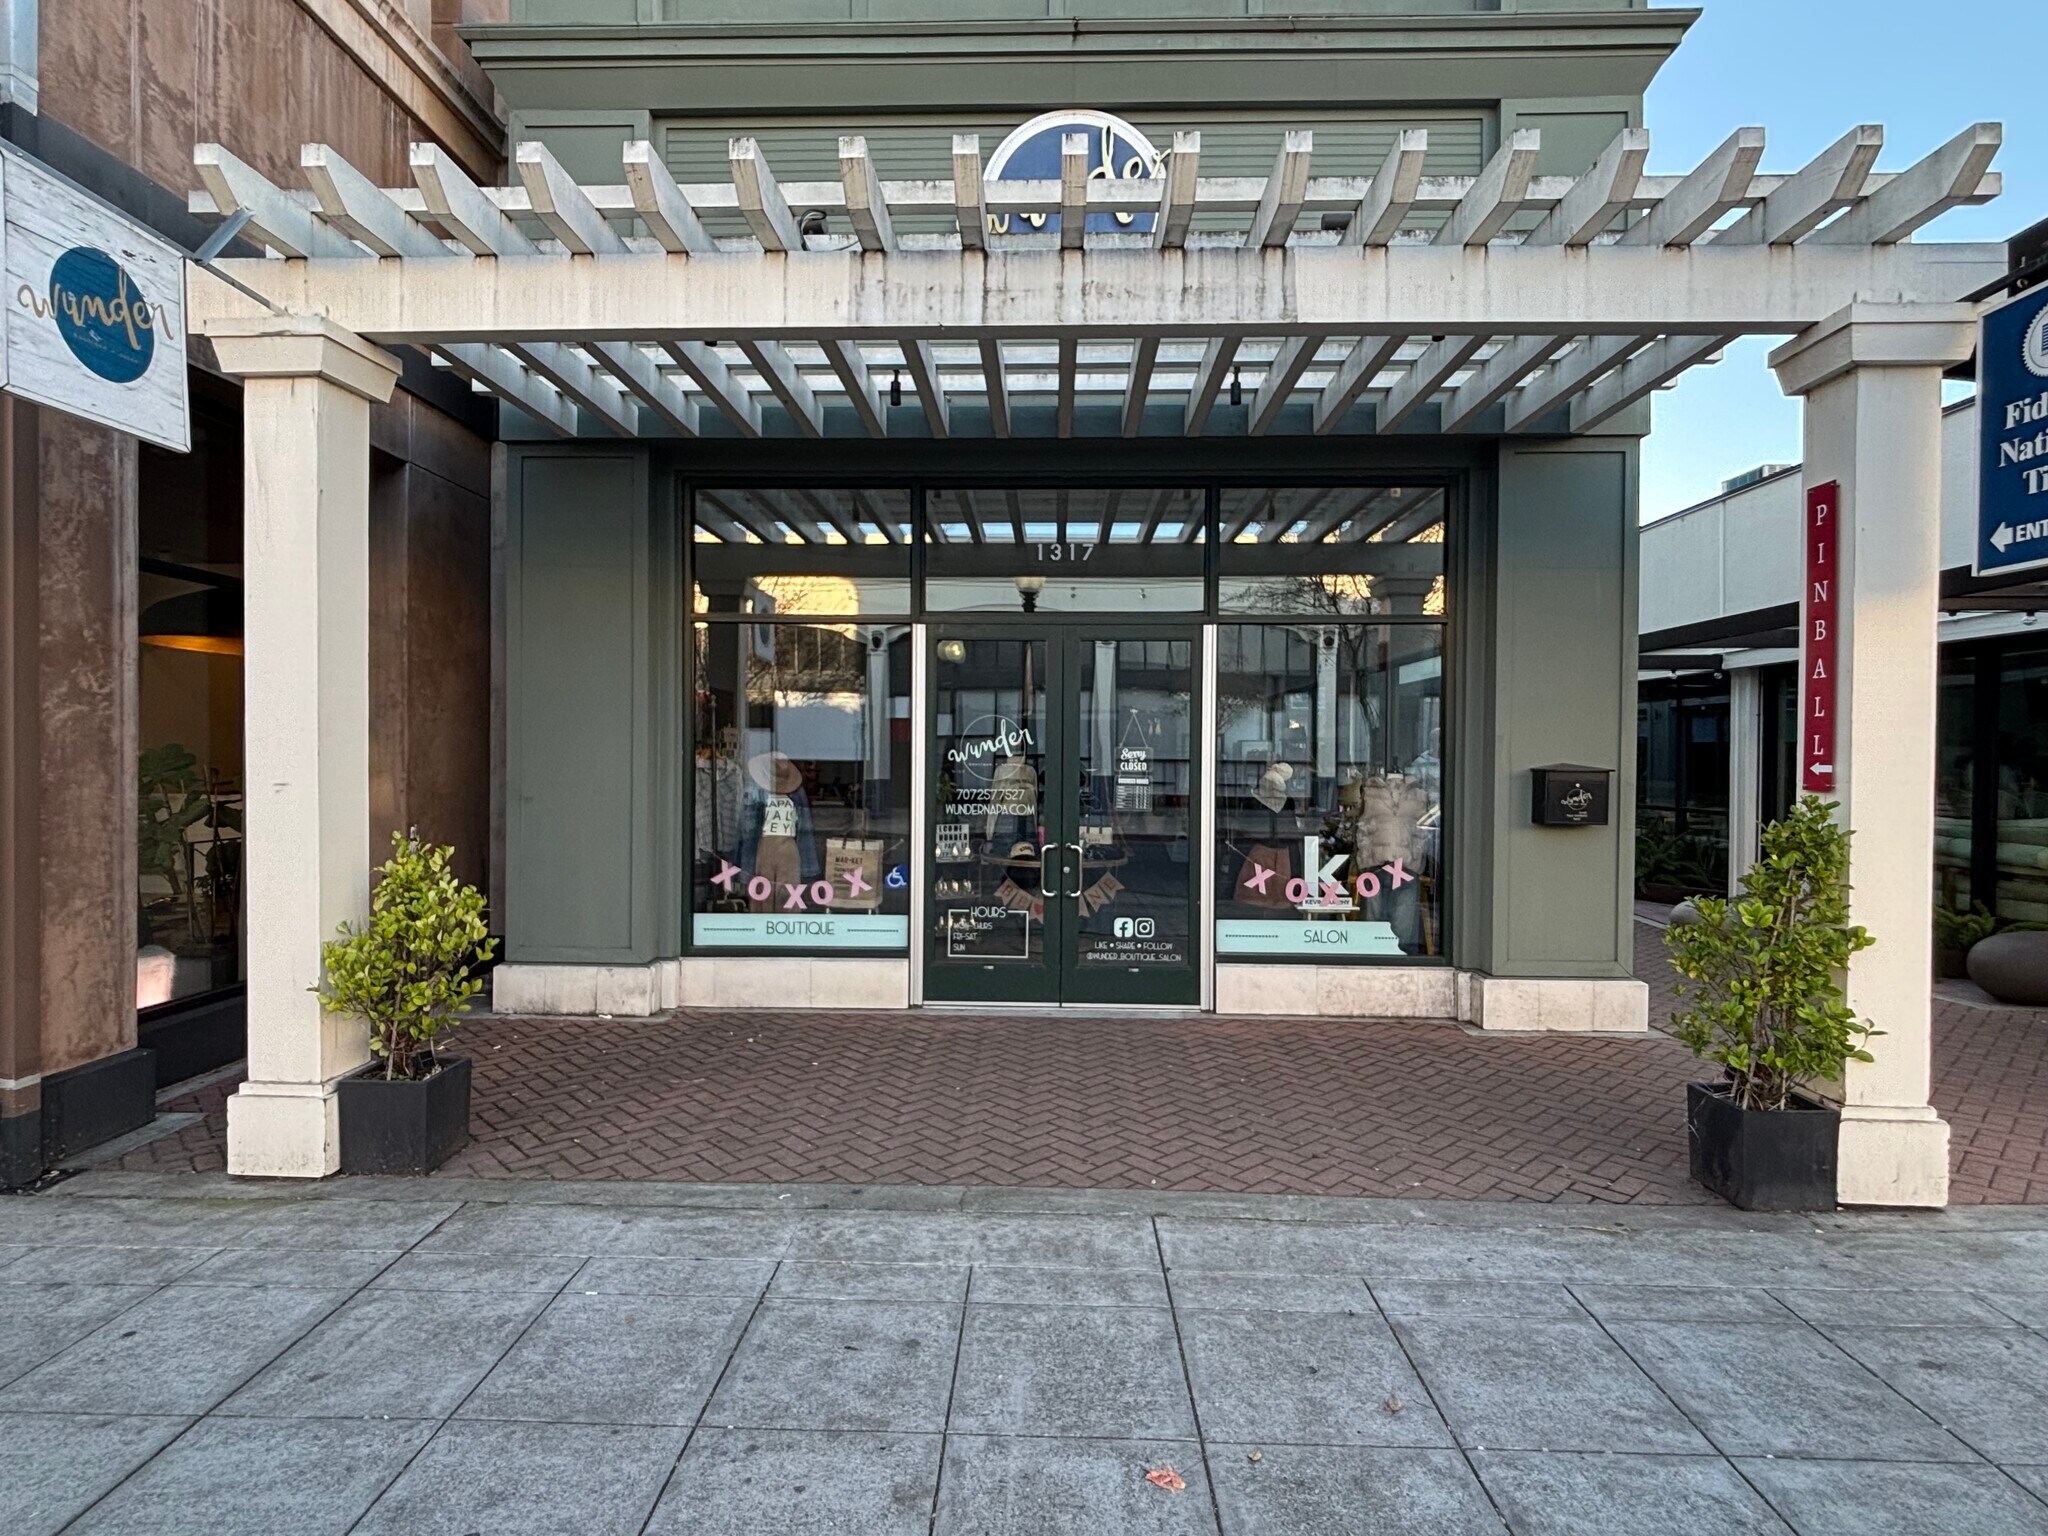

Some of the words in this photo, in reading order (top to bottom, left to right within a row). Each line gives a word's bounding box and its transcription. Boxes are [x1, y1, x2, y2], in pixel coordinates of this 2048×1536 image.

[17, 264, 175, 351] wunder
[1037, 543, 1094, 561] 1317
[1812, 504, 1828, 756] PINBALL
[947, 718, 1034, 762] wunder
[1120, 762, 1148, 771] CLOSED
[956, 788, 1026, 800] 7072577527
[766, 800, 792, 808] APA
[971, 906, 1006, 918] HOURS
[766, 921, 835, 935] BOUTIQUE
[1303, 930, 1348, 943] SALON
[953, 943, 966, 951] SUN
[1094, 941, 1108, 950] LIKE
[1143, 942, 1173, 950] FOLLOW
